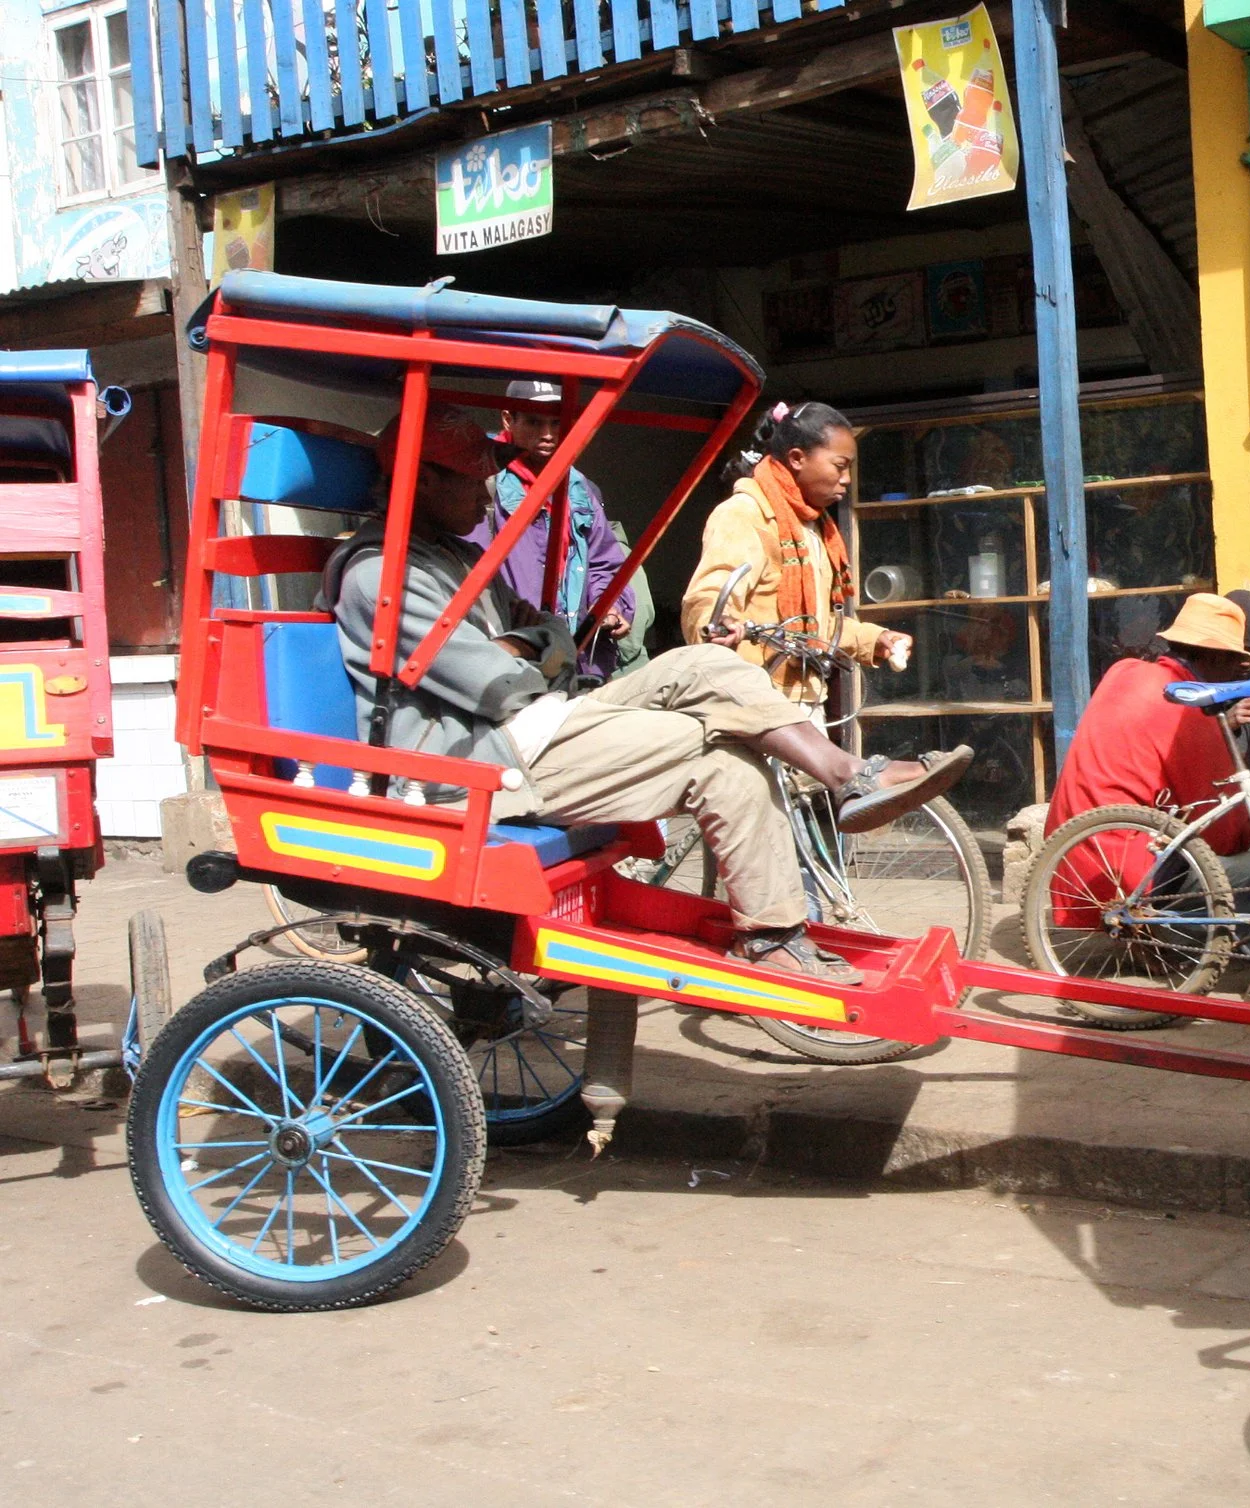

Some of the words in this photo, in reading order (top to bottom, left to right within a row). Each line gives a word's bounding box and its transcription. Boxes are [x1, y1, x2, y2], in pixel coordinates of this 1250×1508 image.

[449, 145, 549, 217] tiko
[442, 230, 478, 252] VITA
[482, 212, 552, 246] MALAGASY
